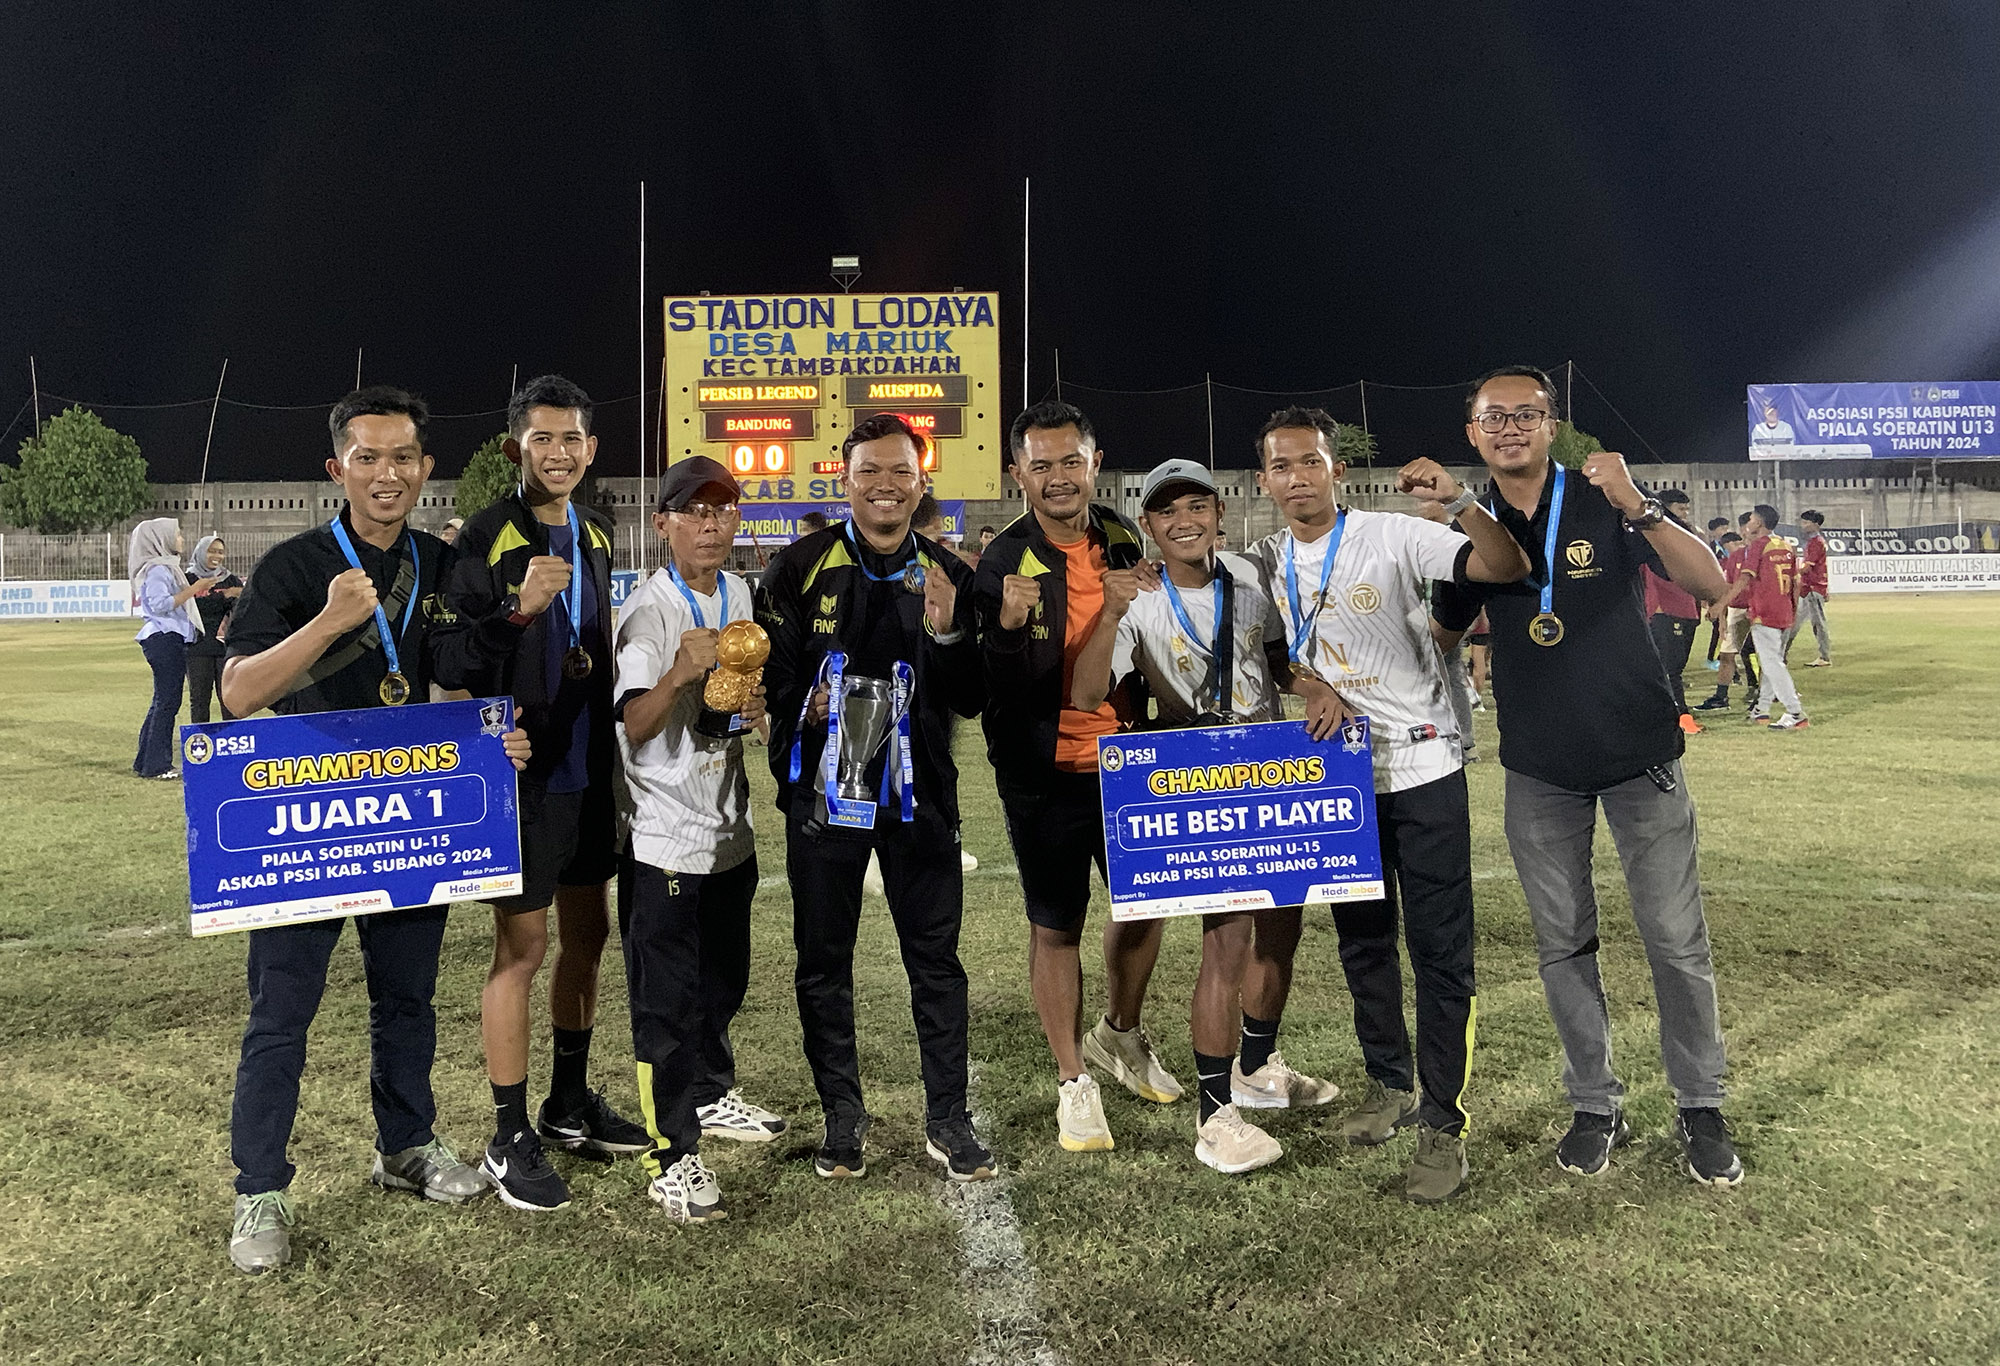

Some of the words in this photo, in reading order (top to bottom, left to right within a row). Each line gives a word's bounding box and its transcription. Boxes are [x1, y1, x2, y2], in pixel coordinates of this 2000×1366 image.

[668, 297, 835, 332] STADION
[853, 296, 994, 328] LODAYA
[709, 333, 796, 357] DESA
[827, 330, 954, 354] MARIUK
[700, 387, 753, 402] PERSIB
[756, 386, 818, 400] LEGEND
[869, 384, 944, 398] MUSPIDA
[1807, 407, 1873, 420] ASOSIASI
[1877, 407, 1908, 420] PSSI
[1913, 405, 1996, 418] KABUPATEN
[726, 418, 791, 431] BANDUNG
[1818, 422, 1867, 437] PIALA
[1872, 421, 1957, 435] SOERATIN
[1962, 420, 1995, 434] U13
[1891, 437, 1942, 449] TAHUN
[1947, 437, 1980, 449] 2024
[1832, 560, 1859, 575] LPK
[1877, 559, 1925, 574] USWAH
[1929, 558, 1989, 573] JAPANESE
[1852, 575, 1896, 583] PROGRAM
[1899, 575, 1938, 583] MAGANG
[1941, 574, 1969, 582] KERJA
[1972, 574, 1985, 582] KE
[50, 584, 110, 599] MARET
[53, 600, 125, 614] MARIUK
[1332, 676, 1379, 690] WEDDING
[216, 735, 256, 751] PSSI
[1126, 747, 1157, 763] PSSI
[244, 742, 460, 791] CHAMPIONS
[1148, 757, 1325, 796] CHAMPIONS
[267, 793, 412, 836] JUARA
[427, 789, 443, 818] 1
[1128, 814, 1179, 839] THE
[1188, 807, 1250, 835] BEST
[1258, 797, 1354, 829] PLAYER
[261, 849, 316, 868] PIALA
[319, 839, 404, 862] SOERATIN
[410, 834, 451, 851] U-15
[1166, 851, 1208, 866] PIALA
[1211, 844, 1282, 861] SOERATIN
[1287, 840, 1321, 855] U-15
[217, 873, 278, 893] ASKAB
[284, 868, 320, 885] PSSI
[326, 864, 367, 881] KAB.
[373, 855, 446, 874] SUBANG
[452, 847, 492, 865] 2024
[462, 868, 483, 876] Media
[484, 865, 508, 874] Partner
[1132, 871, 1180, 886] ASKAB
[1184, 867, 1214, 881] PSSI
[1218, 864, 1252, 878] KAB.
[1256, 858, 1318, 875] SUBANG
[1322, 854, 1357, 868] 2024
[341, 897, 382, 908] SULTAN
[1113, 892, 1137, 900] Support
[1232, 896, 1265, 904] SULTAN
[192, 900, 222, 911] Support
[223, 898, 234, 907] By
